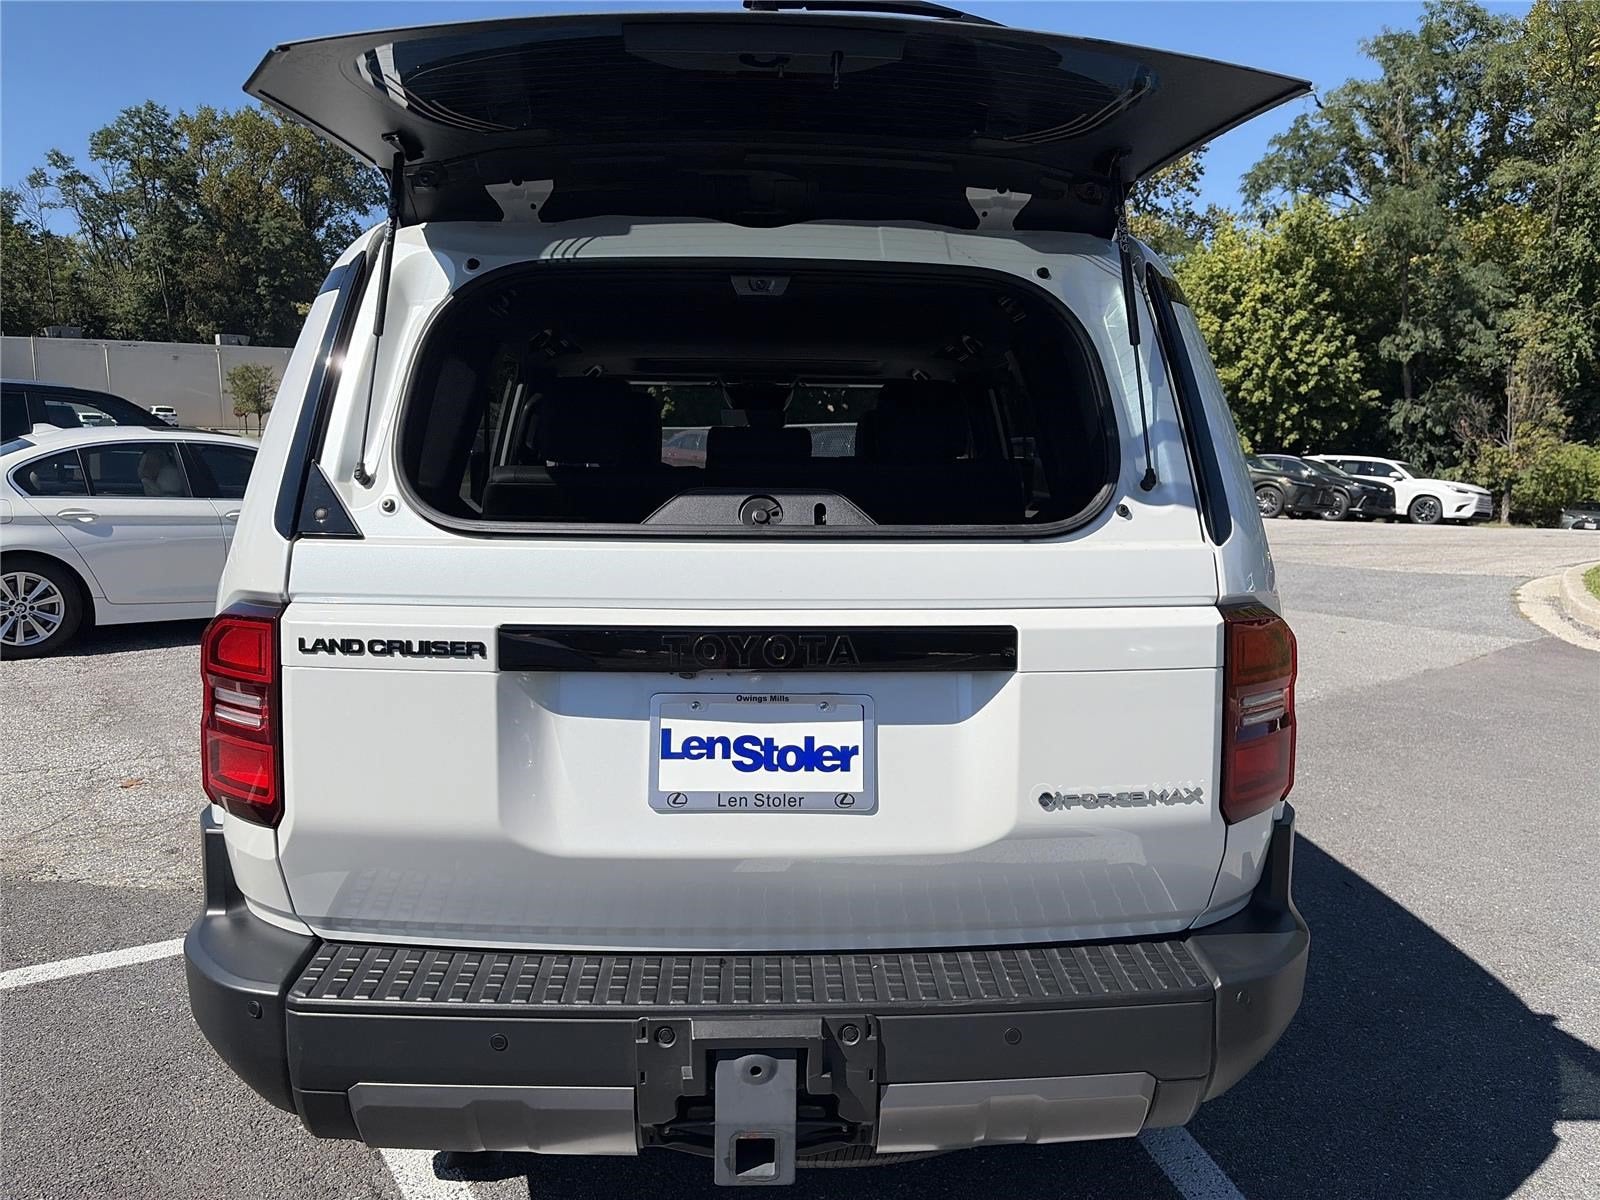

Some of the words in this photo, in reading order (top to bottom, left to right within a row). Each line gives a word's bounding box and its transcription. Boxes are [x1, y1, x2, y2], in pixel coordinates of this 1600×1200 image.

[298, 637, 366, 656] LAND
[367, 639, 488, 660] CRUISER
[661, 634, 861, 668] TOYOTA
[736, 694, 768, 704] Owings
[770, 694, 790, 703] Mills
[717, 793, 748, 808] Len
[753, 793, 805, 808] Stoler
